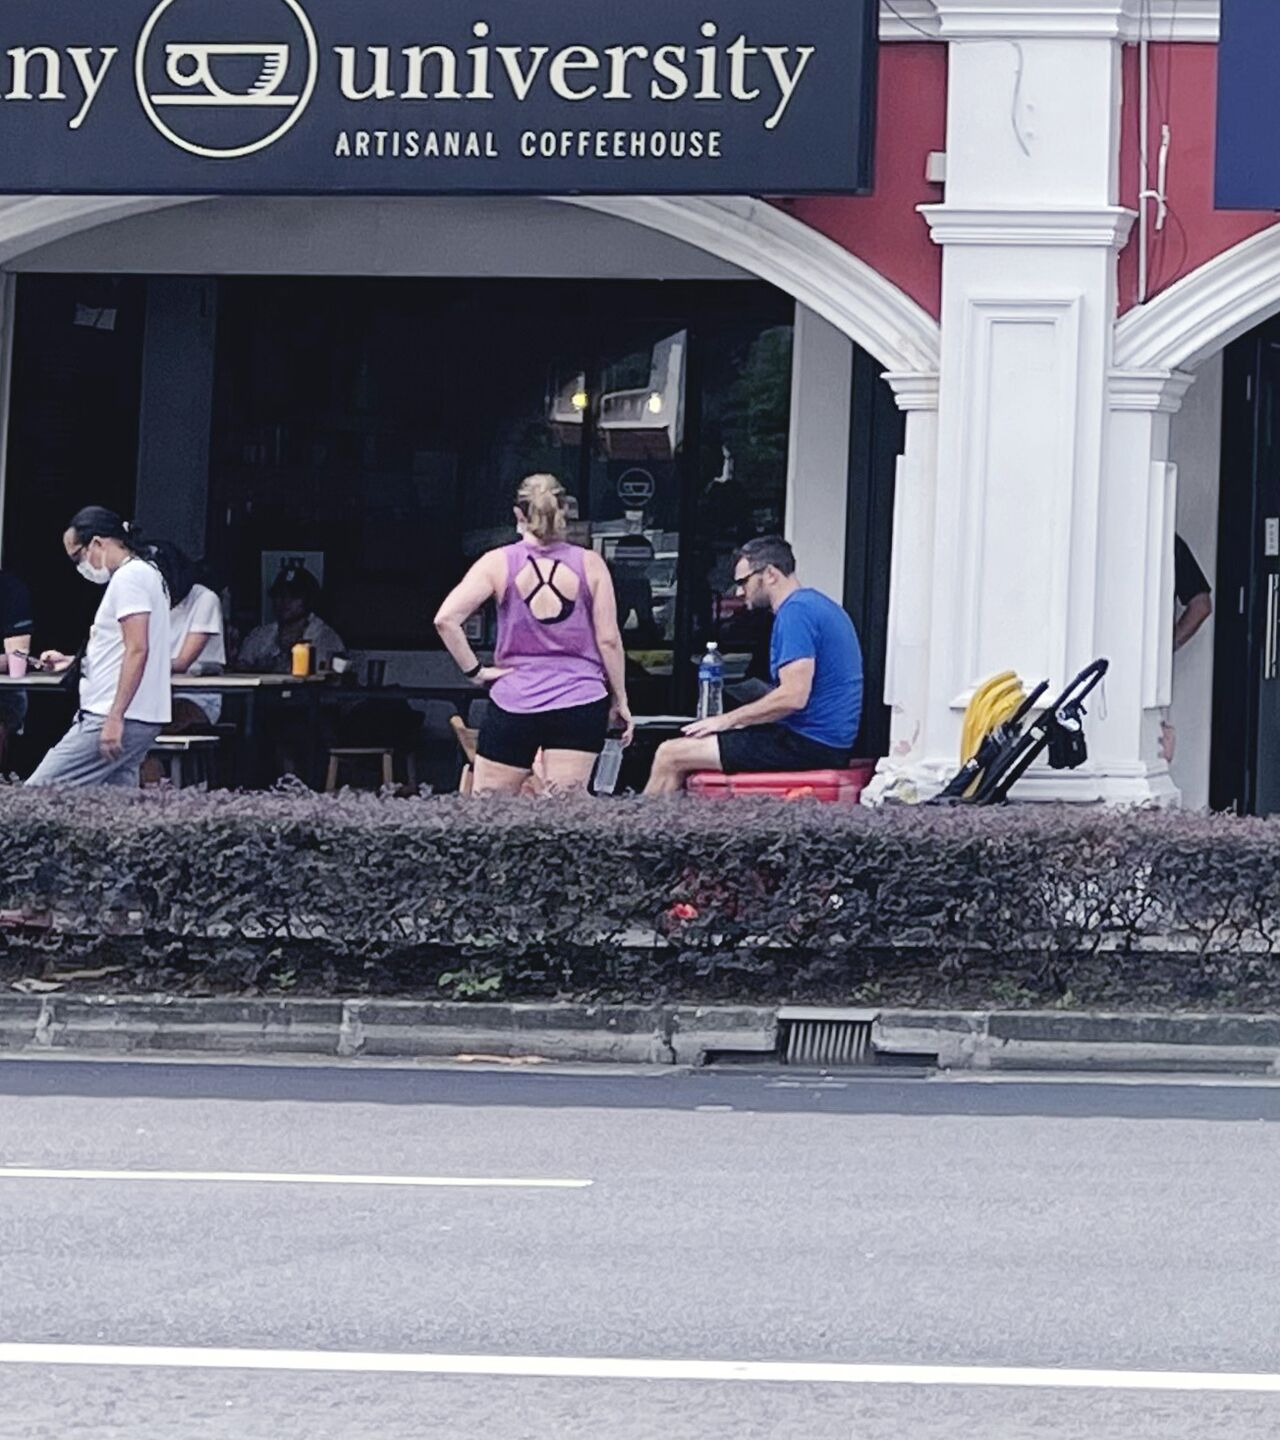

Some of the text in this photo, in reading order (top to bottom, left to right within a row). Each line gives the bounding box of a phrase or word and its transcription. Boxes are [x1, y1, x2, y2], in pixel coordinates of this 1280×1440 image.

[0, 22, 815, 130] ny university
[335, 130, 722, 158] ARTISANAL COFFEEHOUSE
